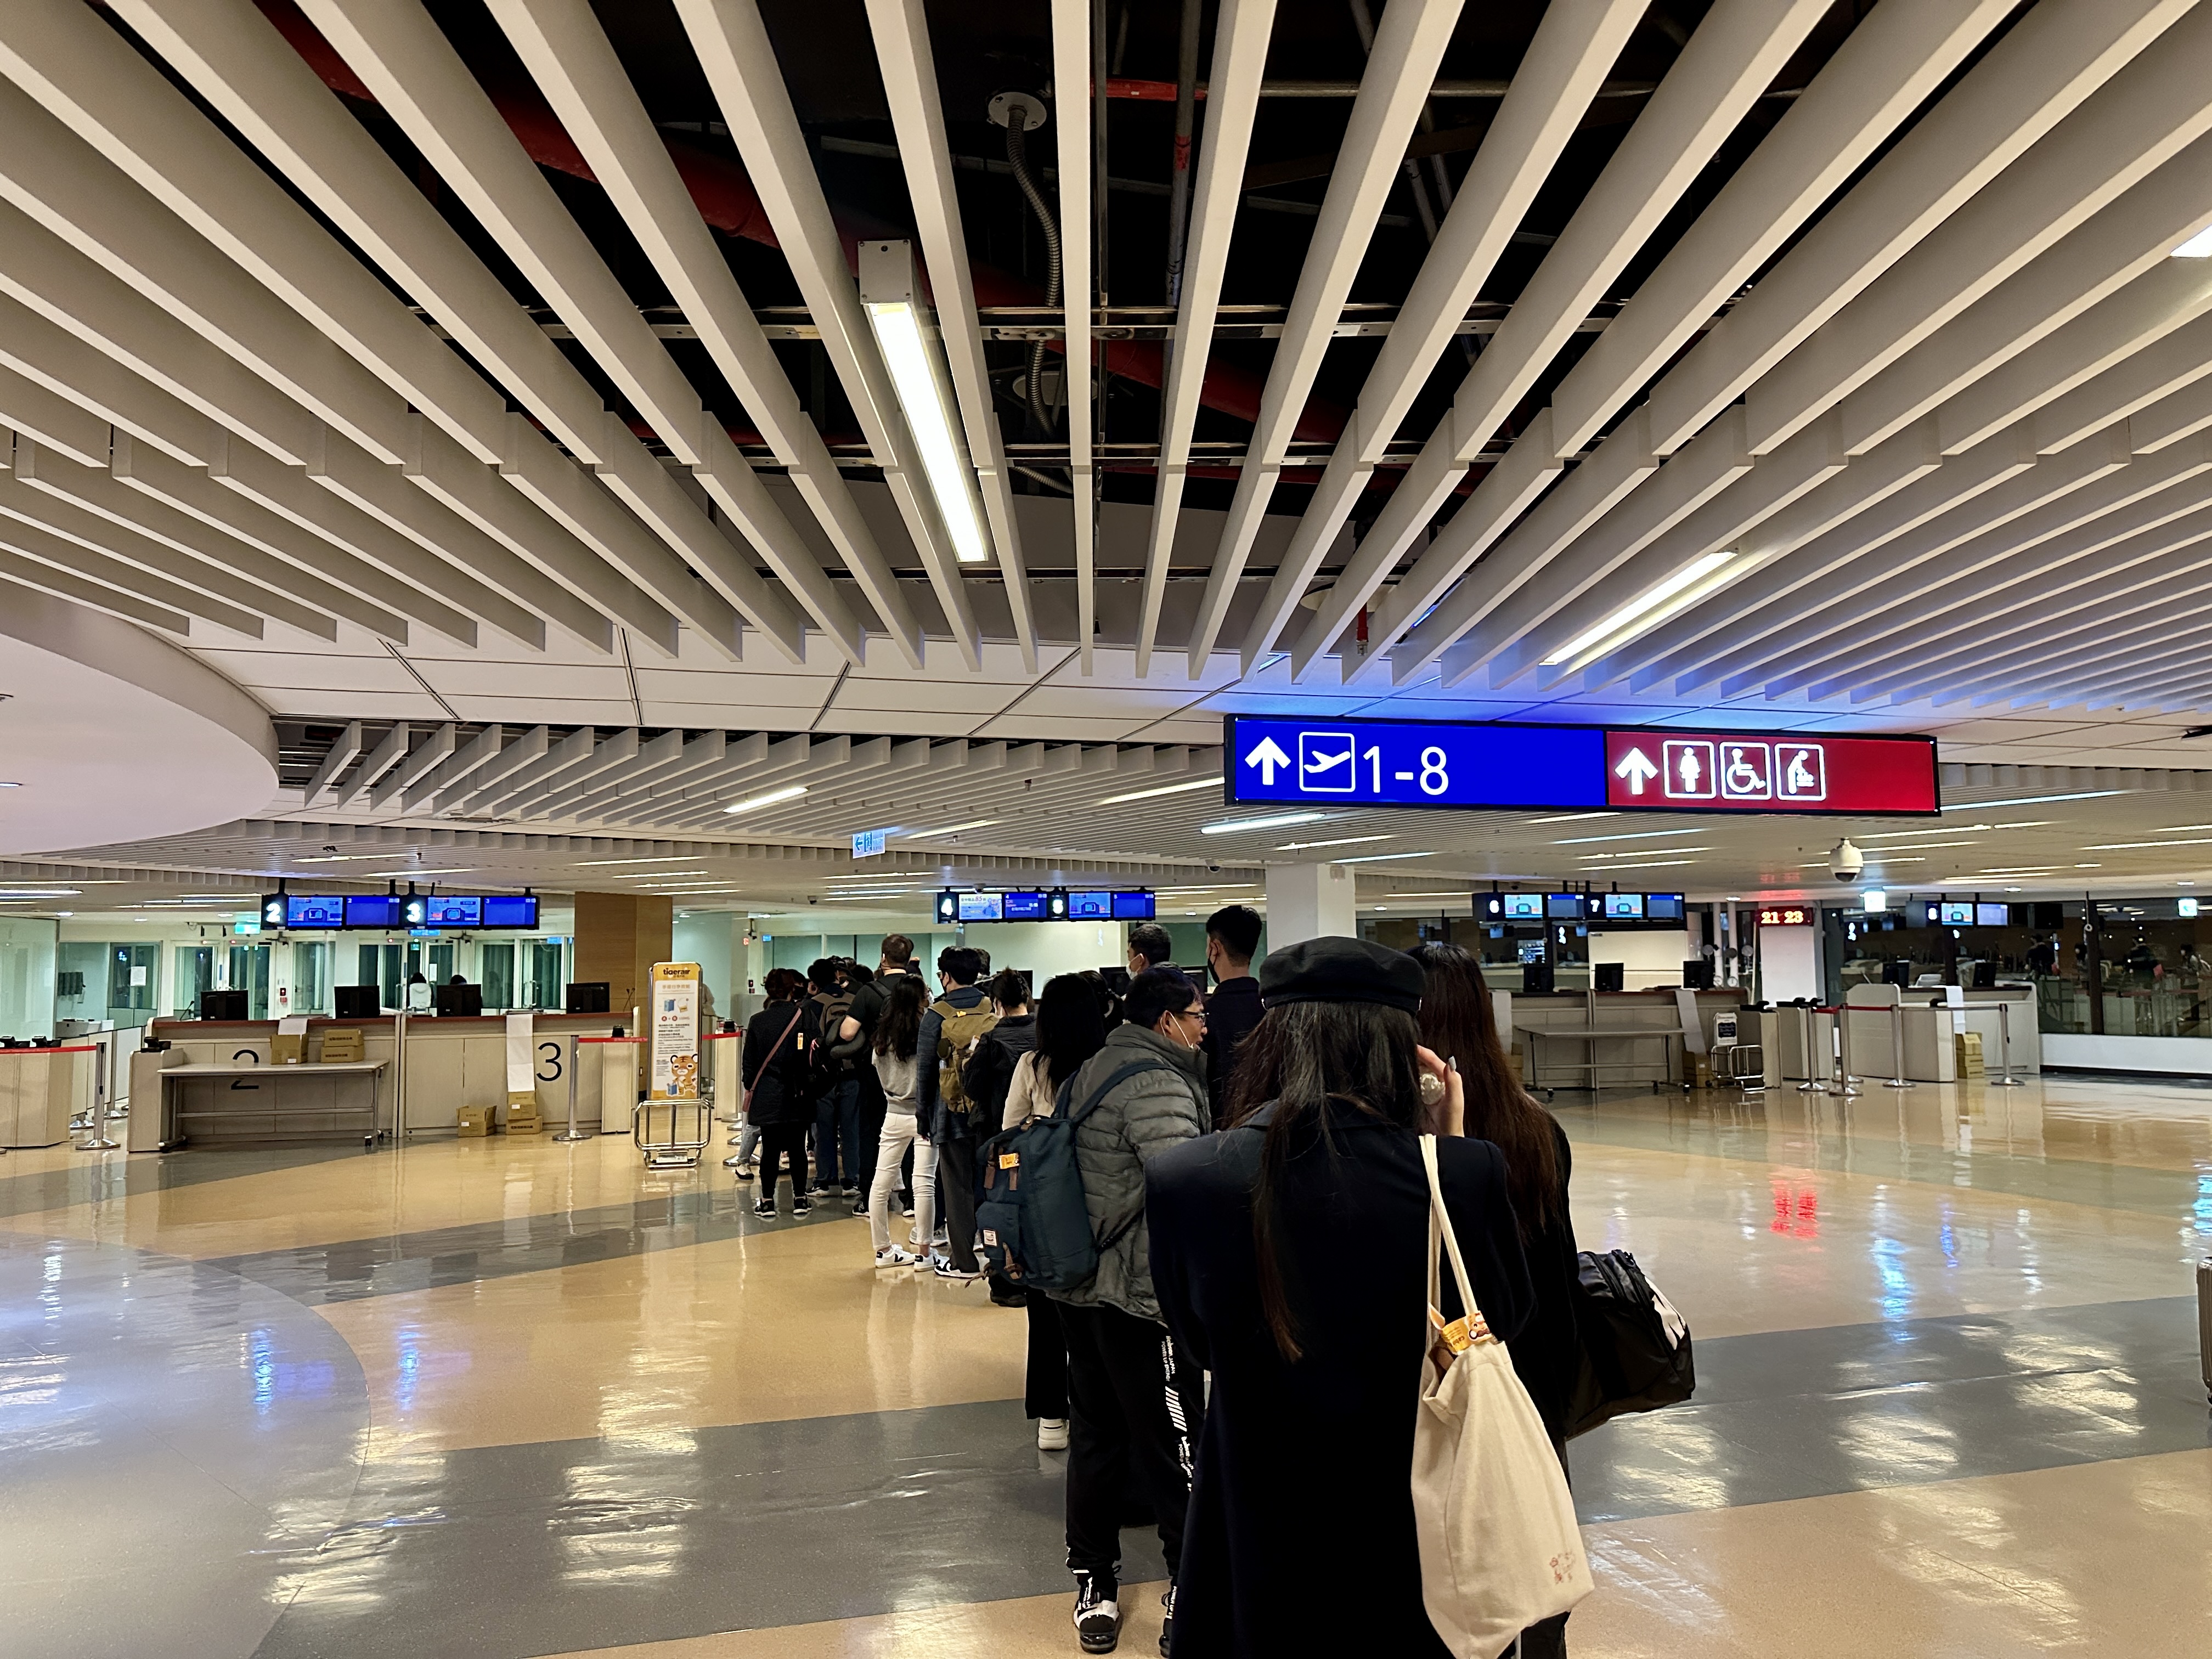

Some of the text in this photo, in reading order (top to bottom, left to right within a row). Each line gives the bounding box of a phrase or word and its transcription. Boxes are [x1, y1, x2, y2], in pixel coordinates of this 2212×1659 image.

[1363, 746, 1449, 795] 1-8
[266, 903, 281, 923] 2
[407, 903, 421, 922] 3
[941, 899, 953, 916] 4
[1590, 899, 1600, 912] 7
[536, 1042, 562, 1081] 3
